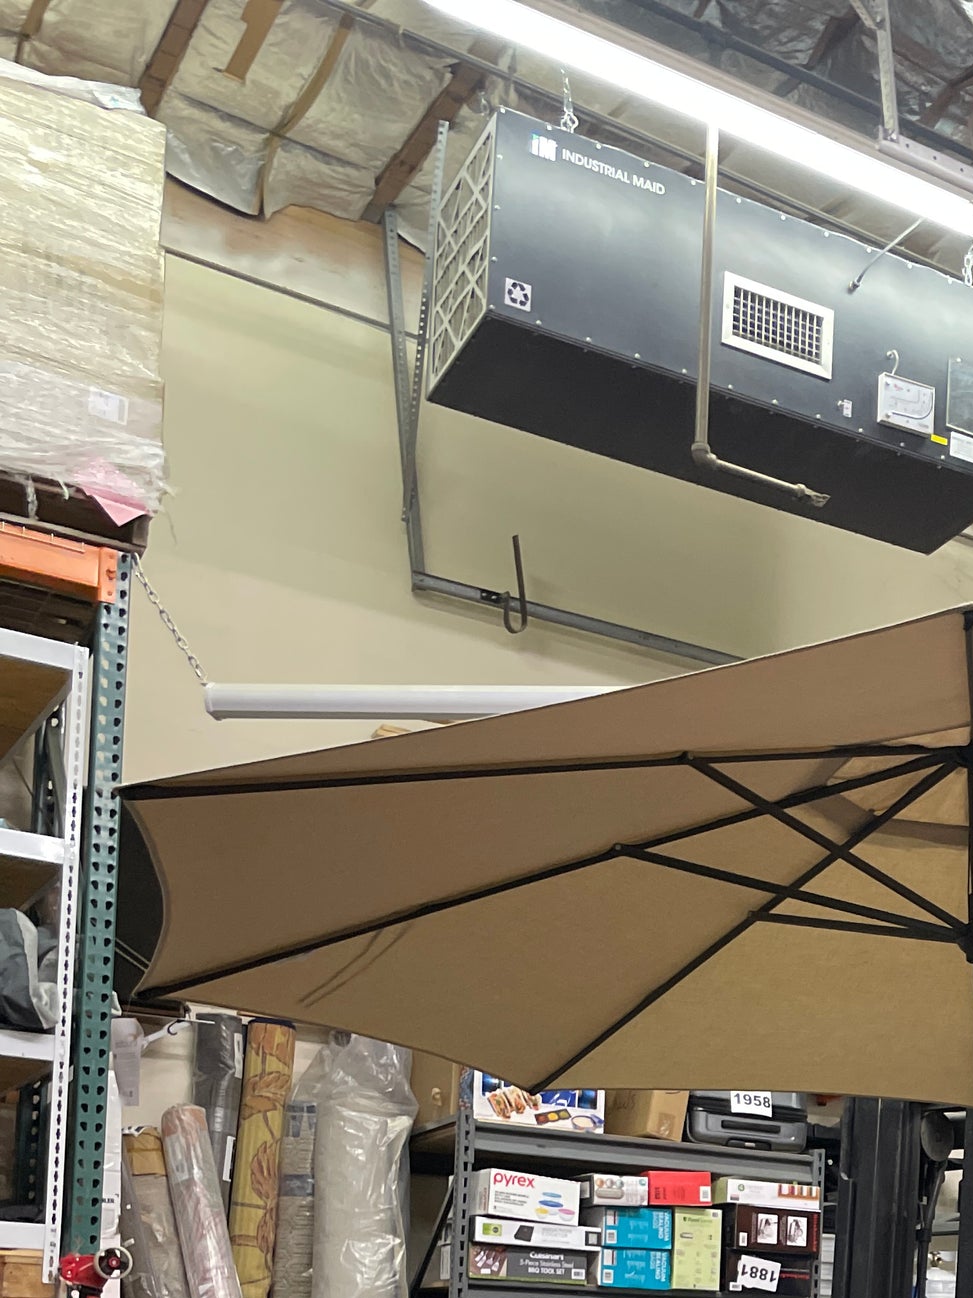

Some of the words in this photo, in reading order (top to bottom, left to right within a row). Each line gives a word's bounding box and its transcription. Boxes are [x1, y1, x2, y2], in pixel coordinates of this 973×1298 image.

[562, 148, 631, 183] INDUSTRIAL
[632, 174, 666, 195] MAID
[733, 1093, 771, 1108] 1958
[493, 1172, 535, 1189] pyrex
[529, 1251, 564, 1260] Cuisinart
[740, 1264, 777, 1283] 1881
